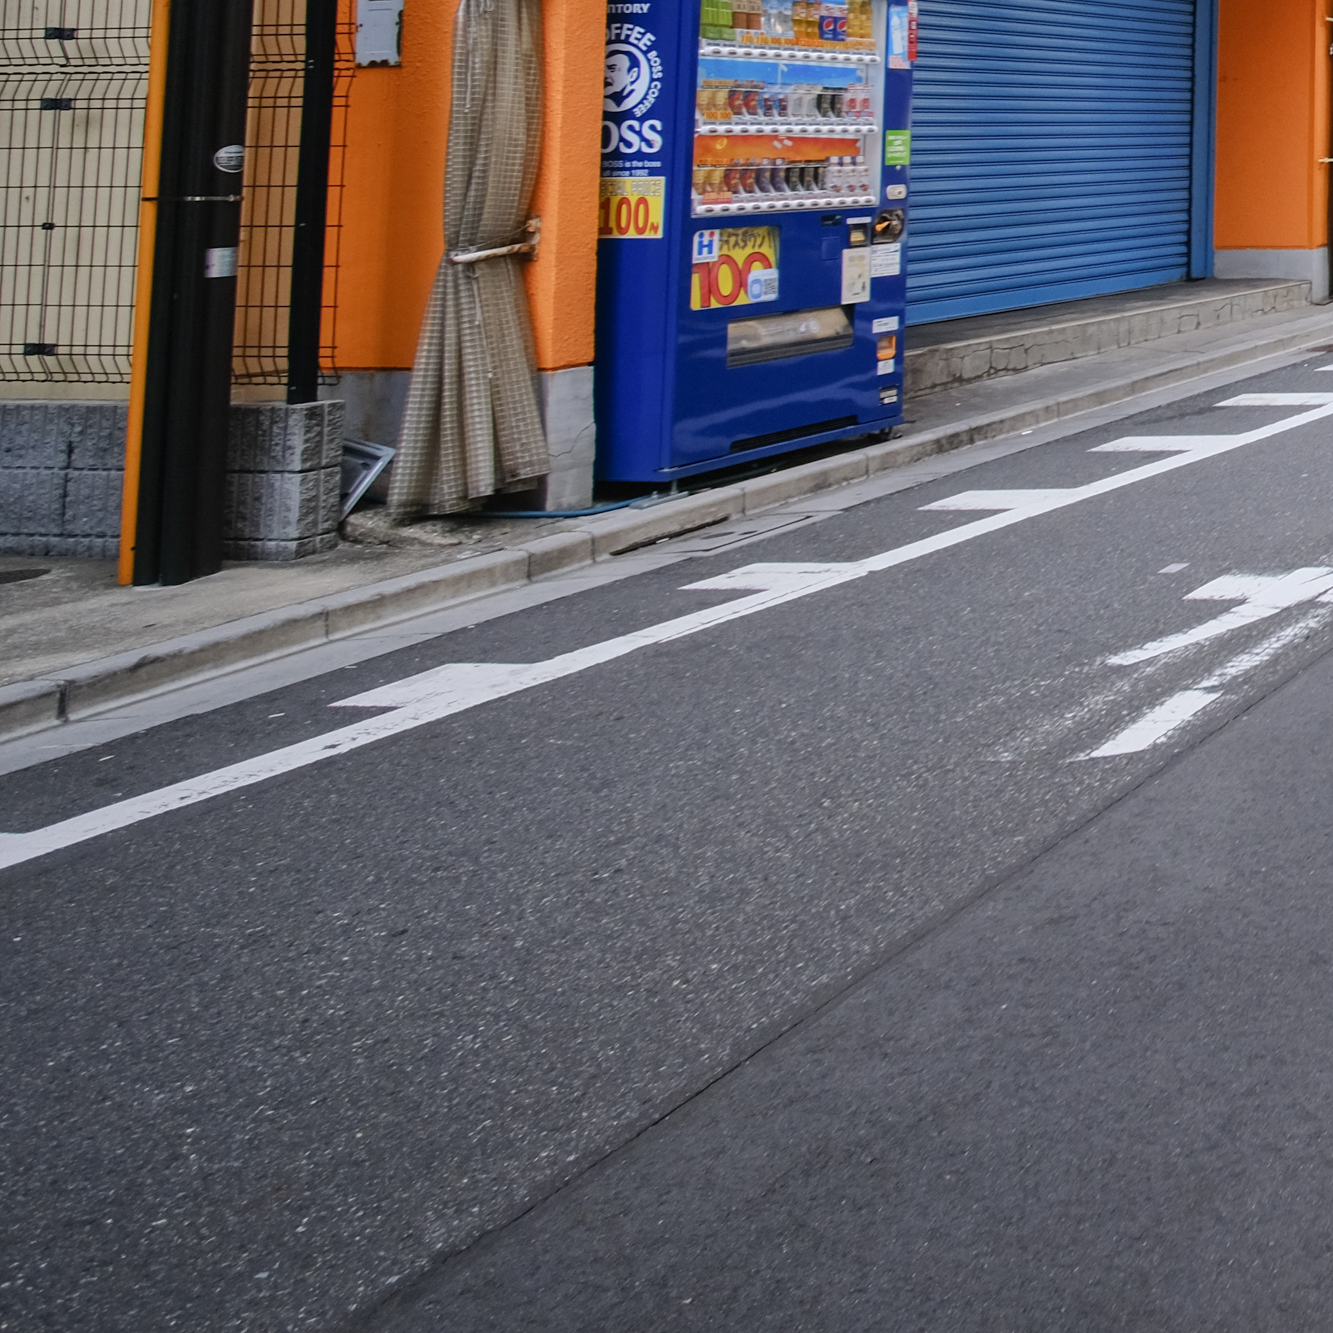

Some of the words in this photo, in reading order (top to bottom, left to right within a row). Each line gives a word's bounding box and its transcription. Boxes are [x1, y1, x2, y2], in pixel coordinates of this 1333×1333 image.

[647, 50, 663, 79] BOSS
[633, 82, 662, 117] COFFEE
[632, 160, 643, 168] the
